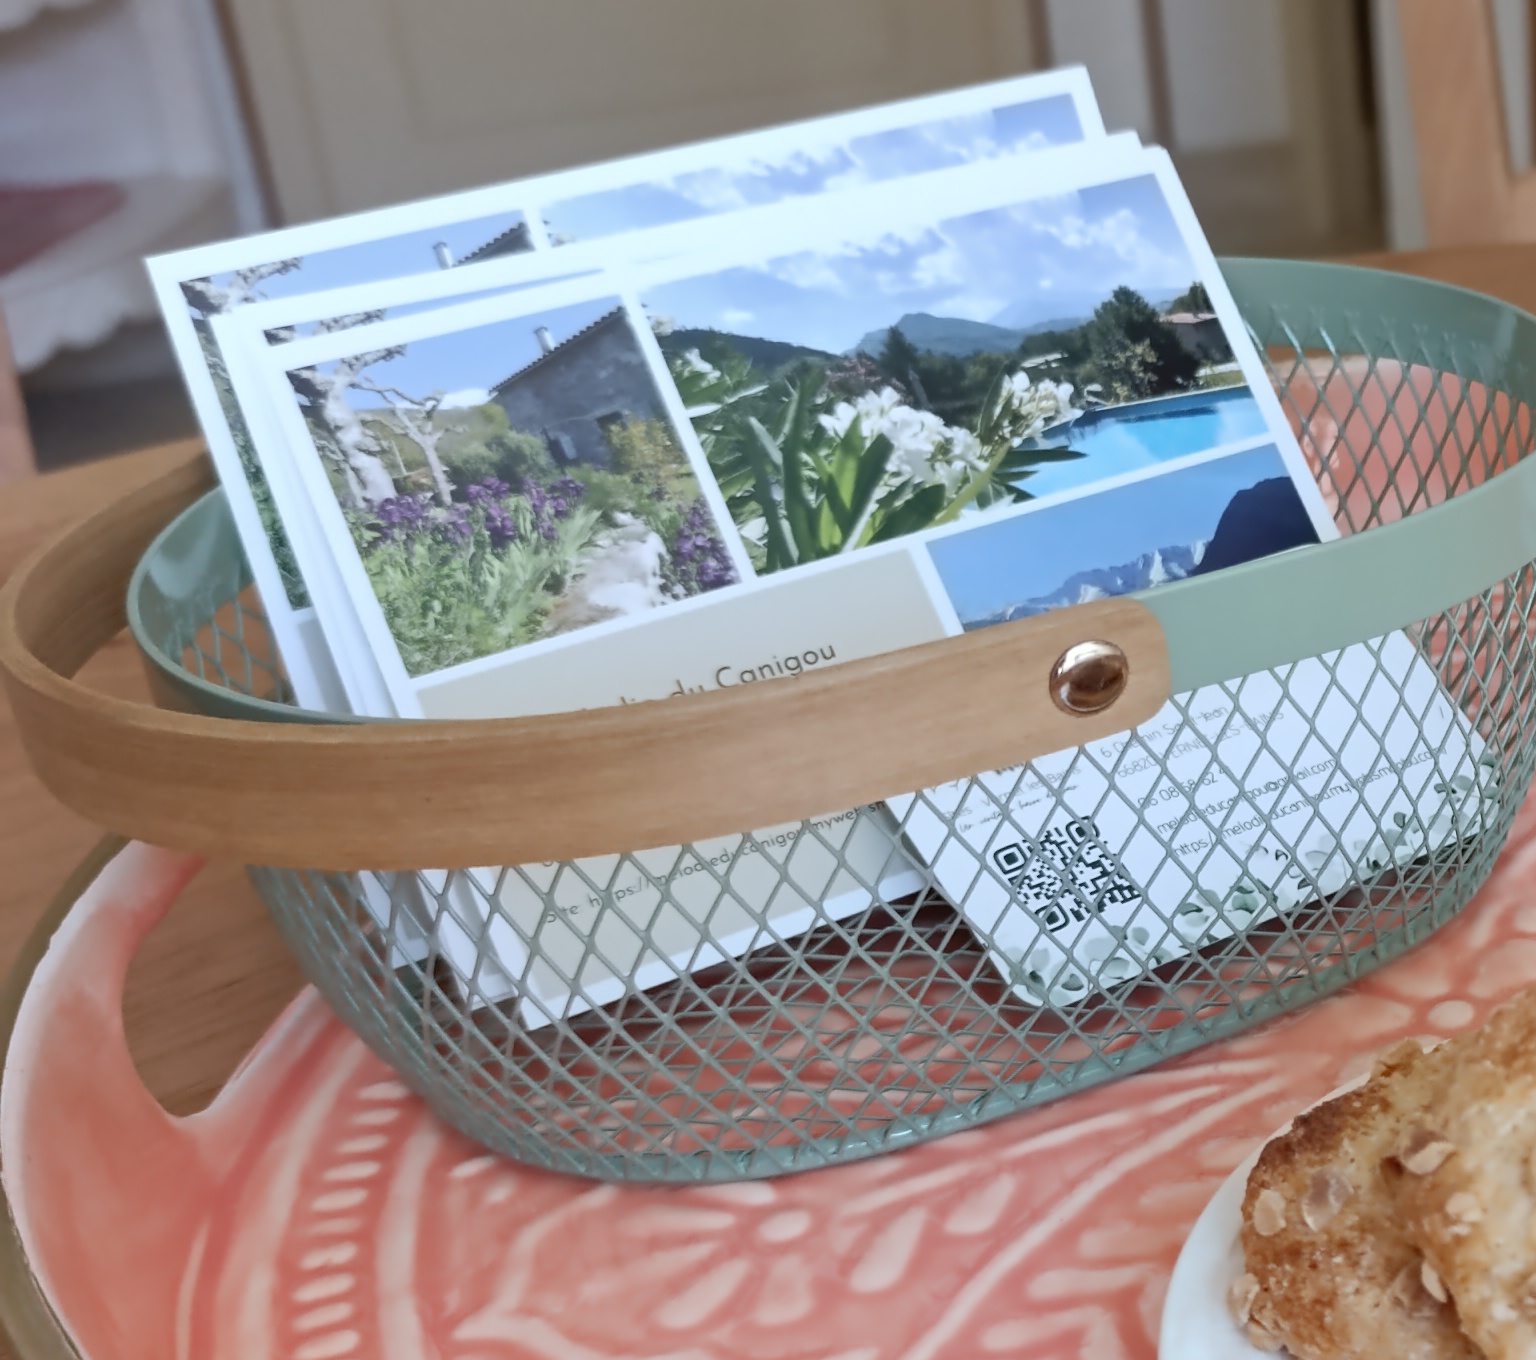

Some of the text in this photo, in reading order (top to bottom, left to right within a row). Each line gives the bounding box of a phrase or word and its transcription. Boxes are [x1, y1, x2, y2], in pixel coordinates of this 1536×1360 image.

[715, 644, 838, 690] Canigou
[1163, 705, 1229, 736] Sat-Jean
[1159, 785, 1180, 801] 08
[546, 903, 581, 924] Ste
